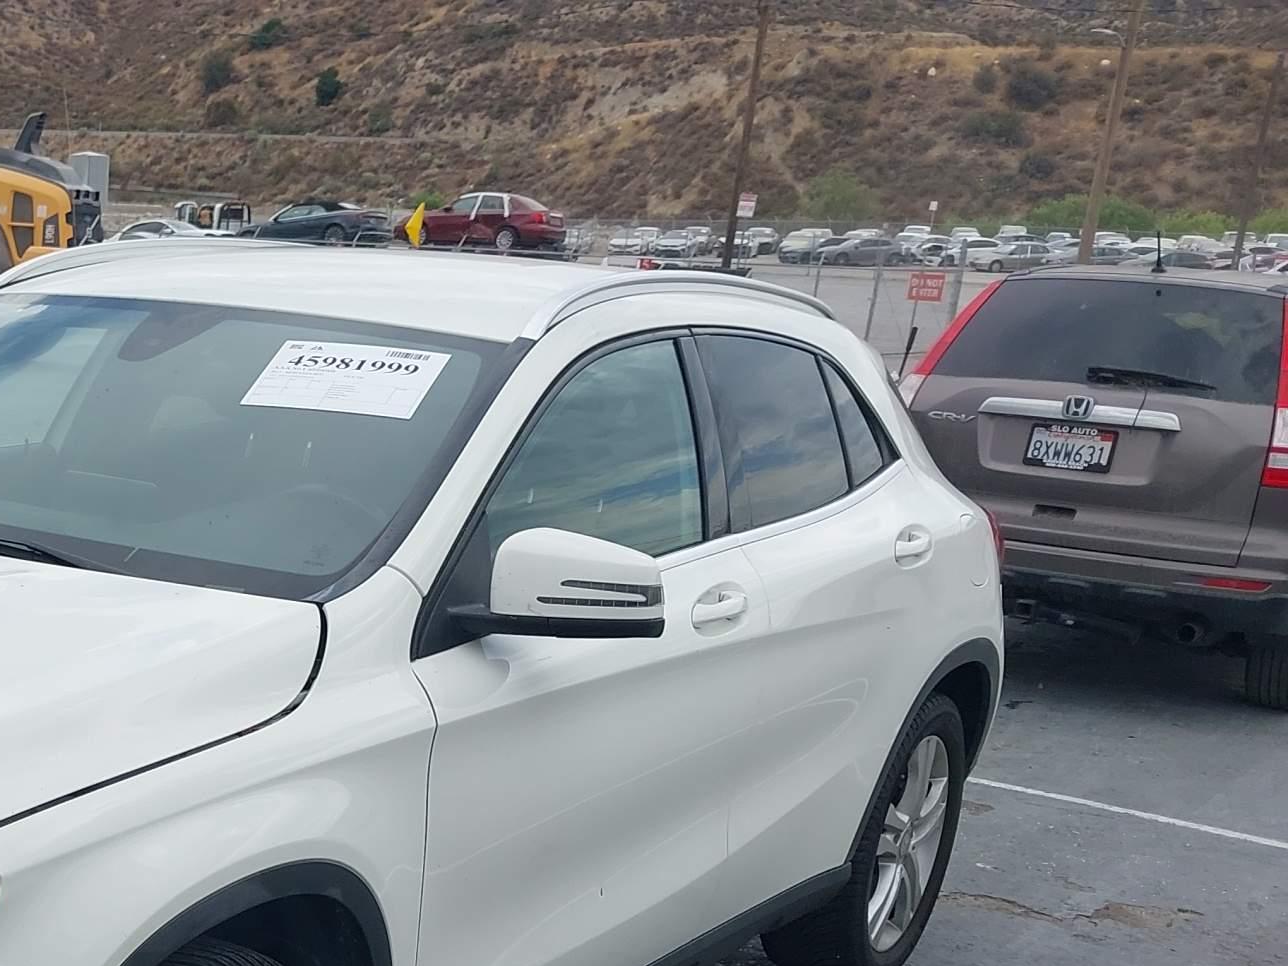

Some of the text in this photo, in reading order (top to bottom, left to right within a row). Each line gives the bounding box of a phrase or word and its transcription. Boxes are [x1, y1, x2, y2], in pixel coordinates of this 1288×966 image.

[925, 279, 943, 288] NOT
[287, 354, 420, 376] 45981999
[1052, 425, 1070, 433] SLO
[1071, 427, 1098, 436] AUTO
[1031, 439, 1105, 464] 8XWW631
